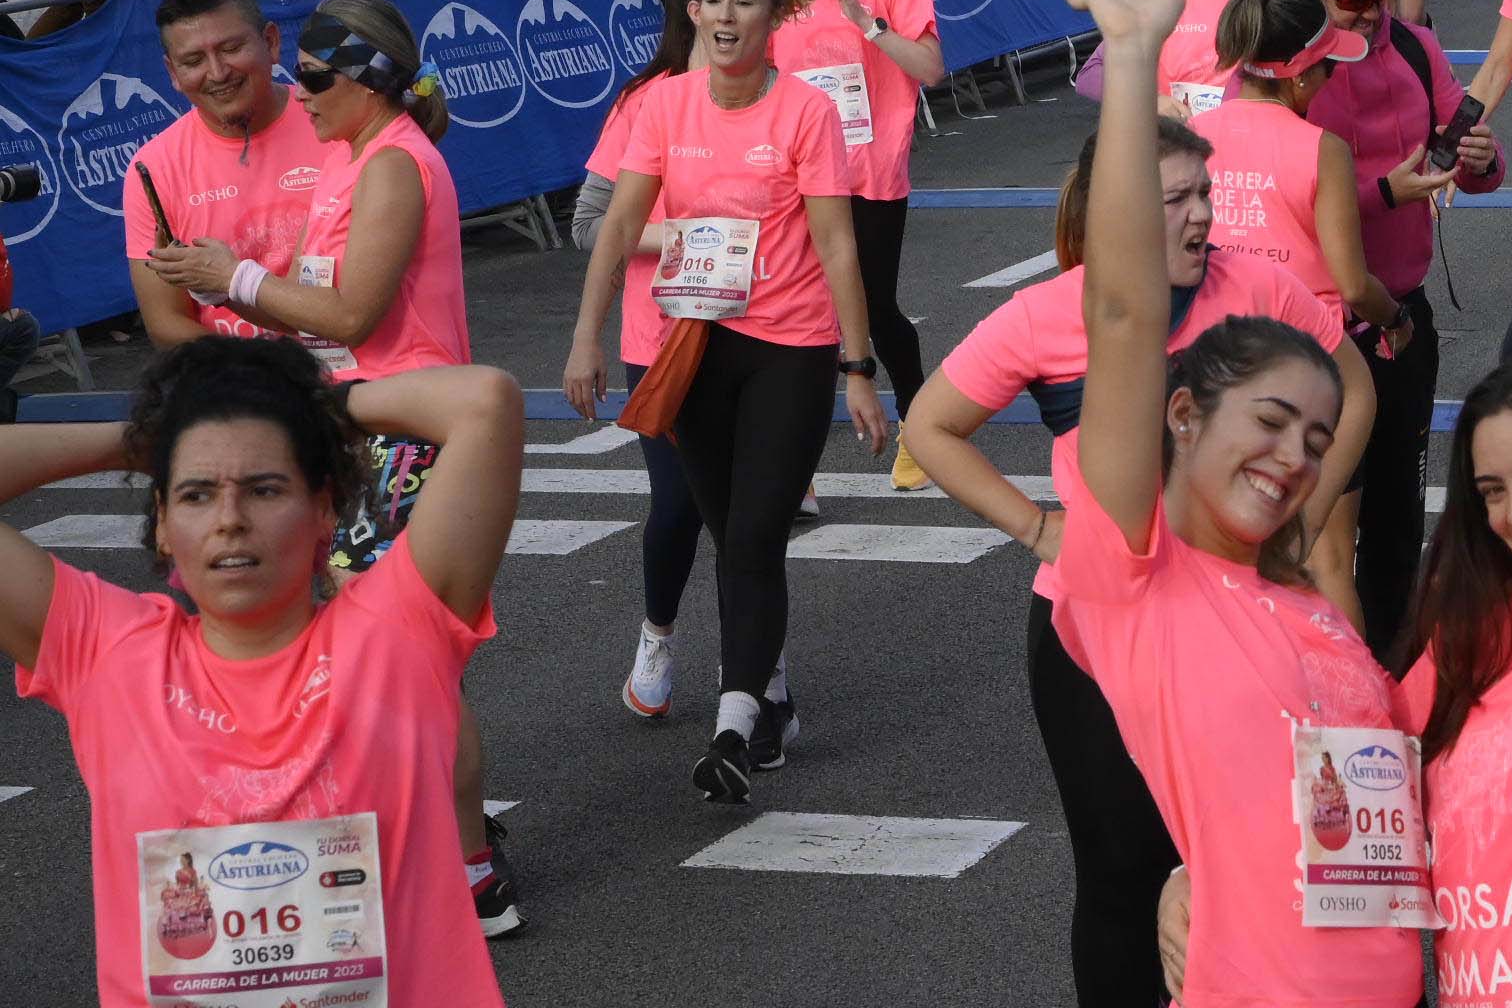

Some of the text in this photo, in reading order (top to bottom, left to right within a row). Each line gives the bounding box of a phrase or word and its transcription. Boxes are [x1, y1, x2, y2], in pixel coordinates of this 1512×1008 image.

[525, 38, 610, 83] ASTURIANA
[0, 138, 36, 156] ECHERA
[282, 174, 321, 189] ASTURIAN
[1210, 171, 1277, 191] ARRERA
[189, 185, 239, 208] OYSHO
[1214, 190, 1264, 209] DE LA
[1211, 209, 1268, 228] MUJER
[684, 257, 715, 272] 016
[683, 274, 708, 285] 18166
[699, 289, 721, 297] MUJER
[1356, 807, 1405, 834] 016
[317, 843, 362, 857] SUMA
[1363, 844, 1402, 860] 13052
[217, 859, 301, 880] ASTURIANA
[1323, 869, 1419, 881] CARRERA DE LA MUJER
[1320, 896, 1367, 912] OYSHO
[222, 904, 302, 938] 016
[232, 944, 295, 966] 30639
[173, 963, 364, 991] CARRERA DE LA MUJER 2023
[299, 990, 371, 1008] Santander
